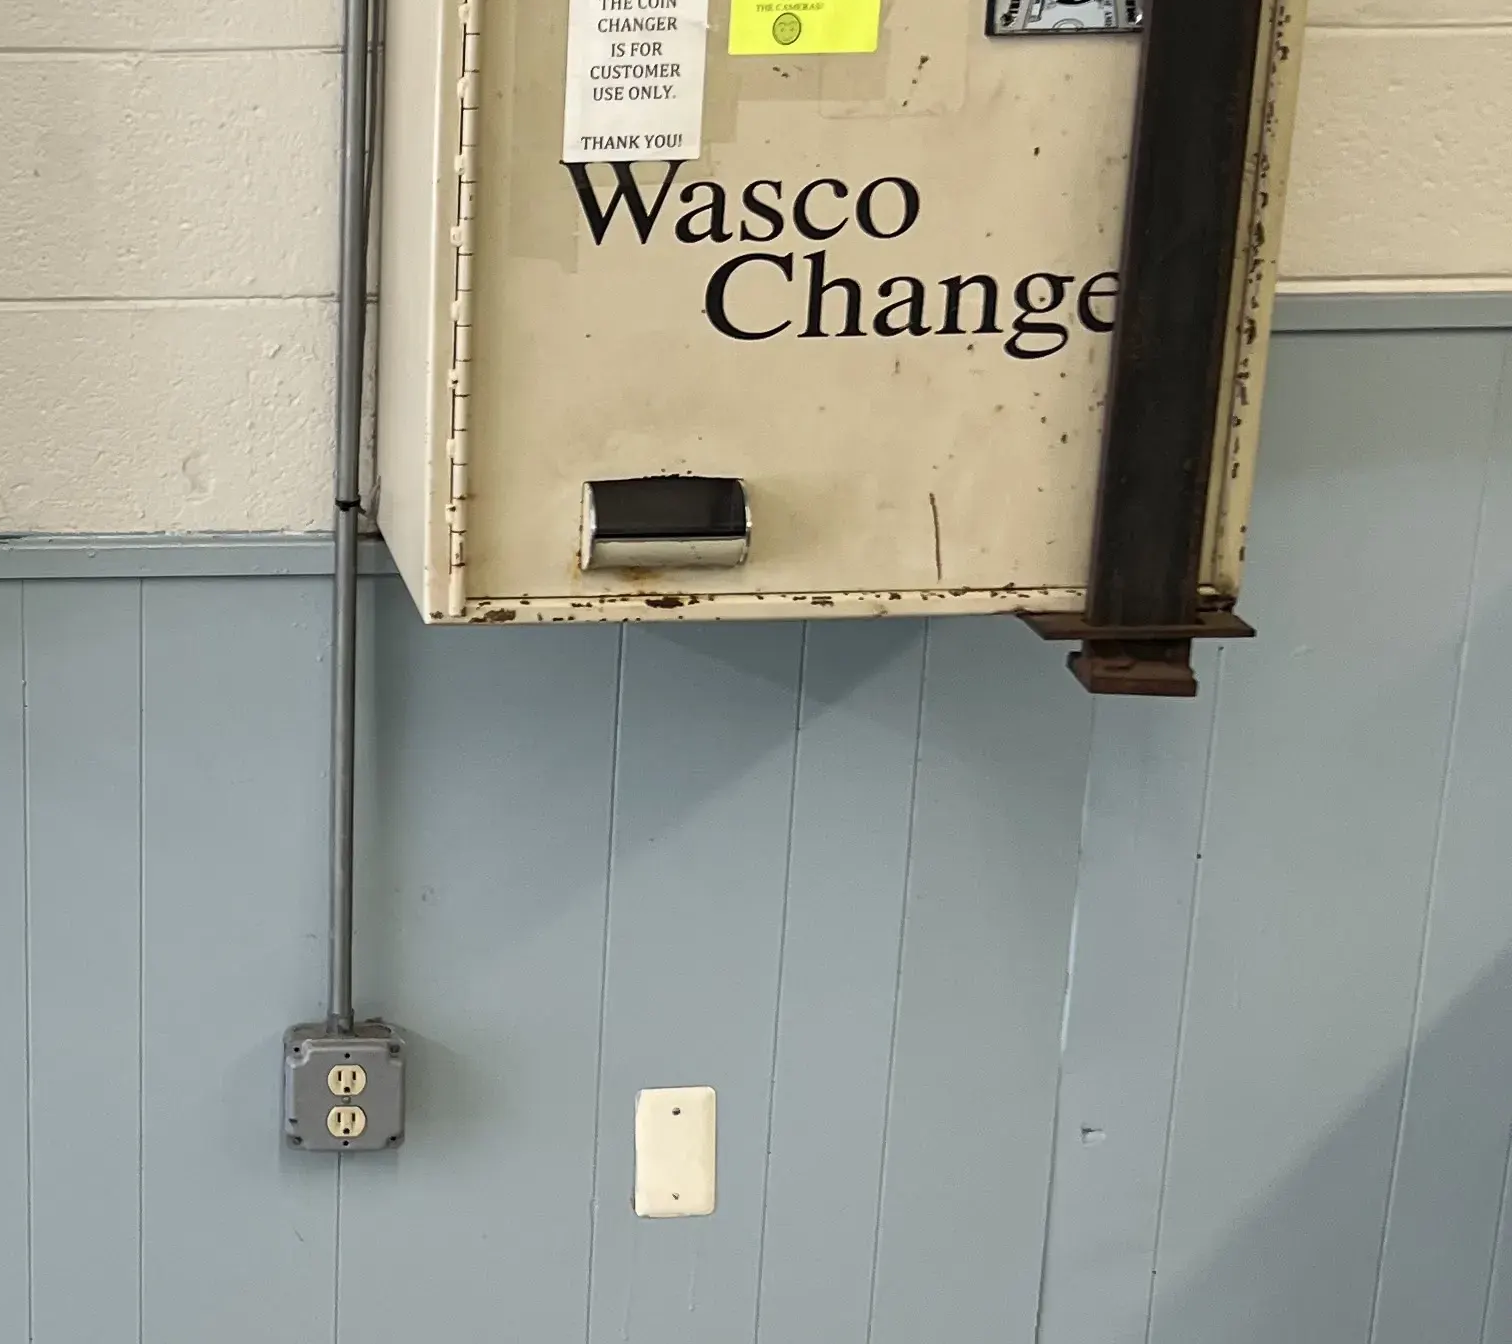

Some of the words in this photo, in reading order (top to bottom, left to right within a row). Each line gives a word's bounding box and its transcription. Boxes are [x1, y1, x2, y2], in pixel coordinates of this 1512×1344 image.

[756, 4, 774, 12] THE
[598, 16, 677, 32] CHANGER
[611, 43, 625, 57] IS
[630, 42, 662, 56] FOR
[590, 64, 680, 80] CUSTOMER
[593, 86, 624, 101] USE
[628, 85, 676, 100] ONLY.
[581, 135, 640, 151] THANK
[645, 133, 683, 148] YOU!
[563, 159, 921, 246] Wasco
